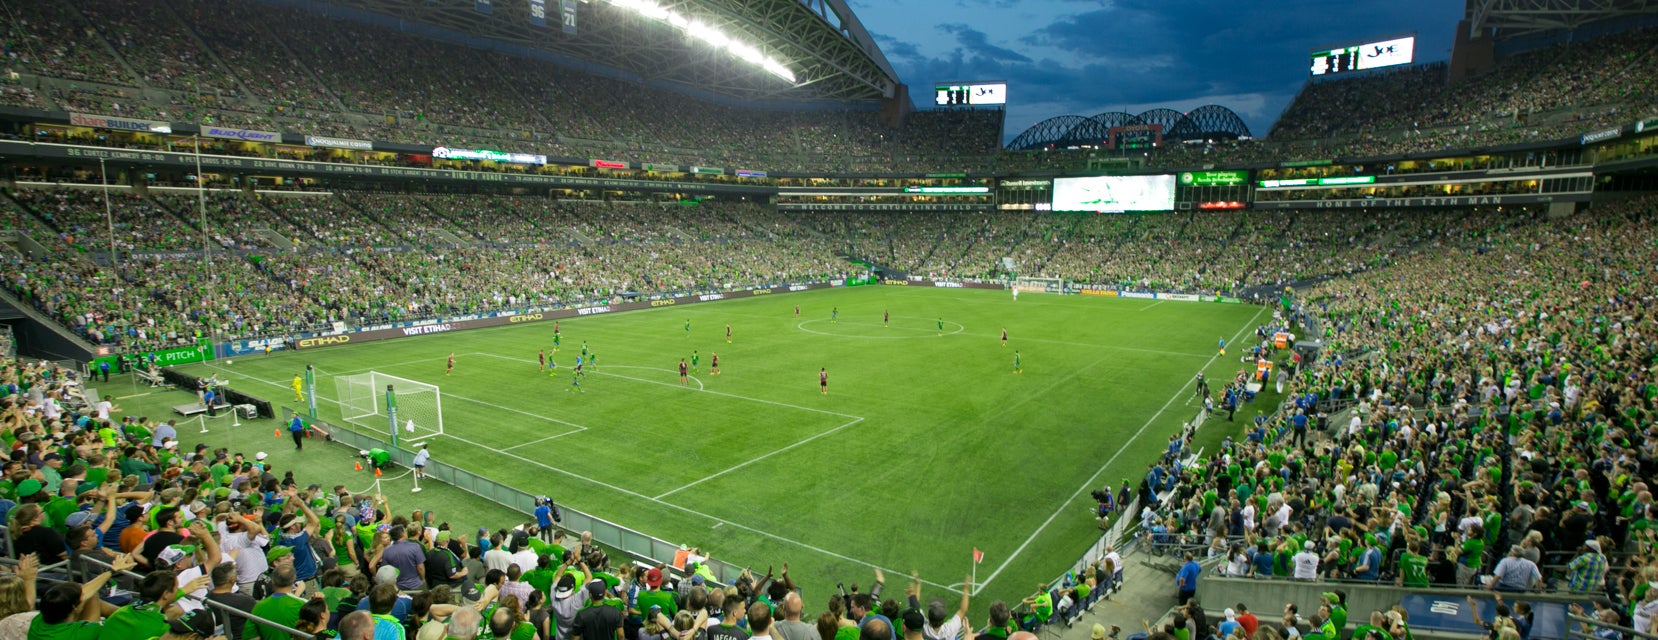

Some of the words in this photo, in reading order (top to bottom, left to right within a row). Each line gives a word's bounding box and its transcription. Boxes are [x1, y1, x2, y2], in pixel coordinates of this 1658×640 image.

[531, 4, 545, 19] 96
[563, 13, 575, 27] 71
[209, 128, 237, 138] BUD
[240, 129, 276, 140] LIGHT
[1421, 198, 1457, 206] 12TH
[1468, 196, 1501, 205] MAN
[651, 299, 675, 307] ETIHAD
[577, 308, 591, 316] VISIT
[509, 313, 543, 323] ETIHAD
[402, 326, 423, 336] VISIT
[423, 324, 451, 334] ETIHAD
[299, 335, 350, 347] ETIHAD
[166, 350, 195, 361] PITCH
